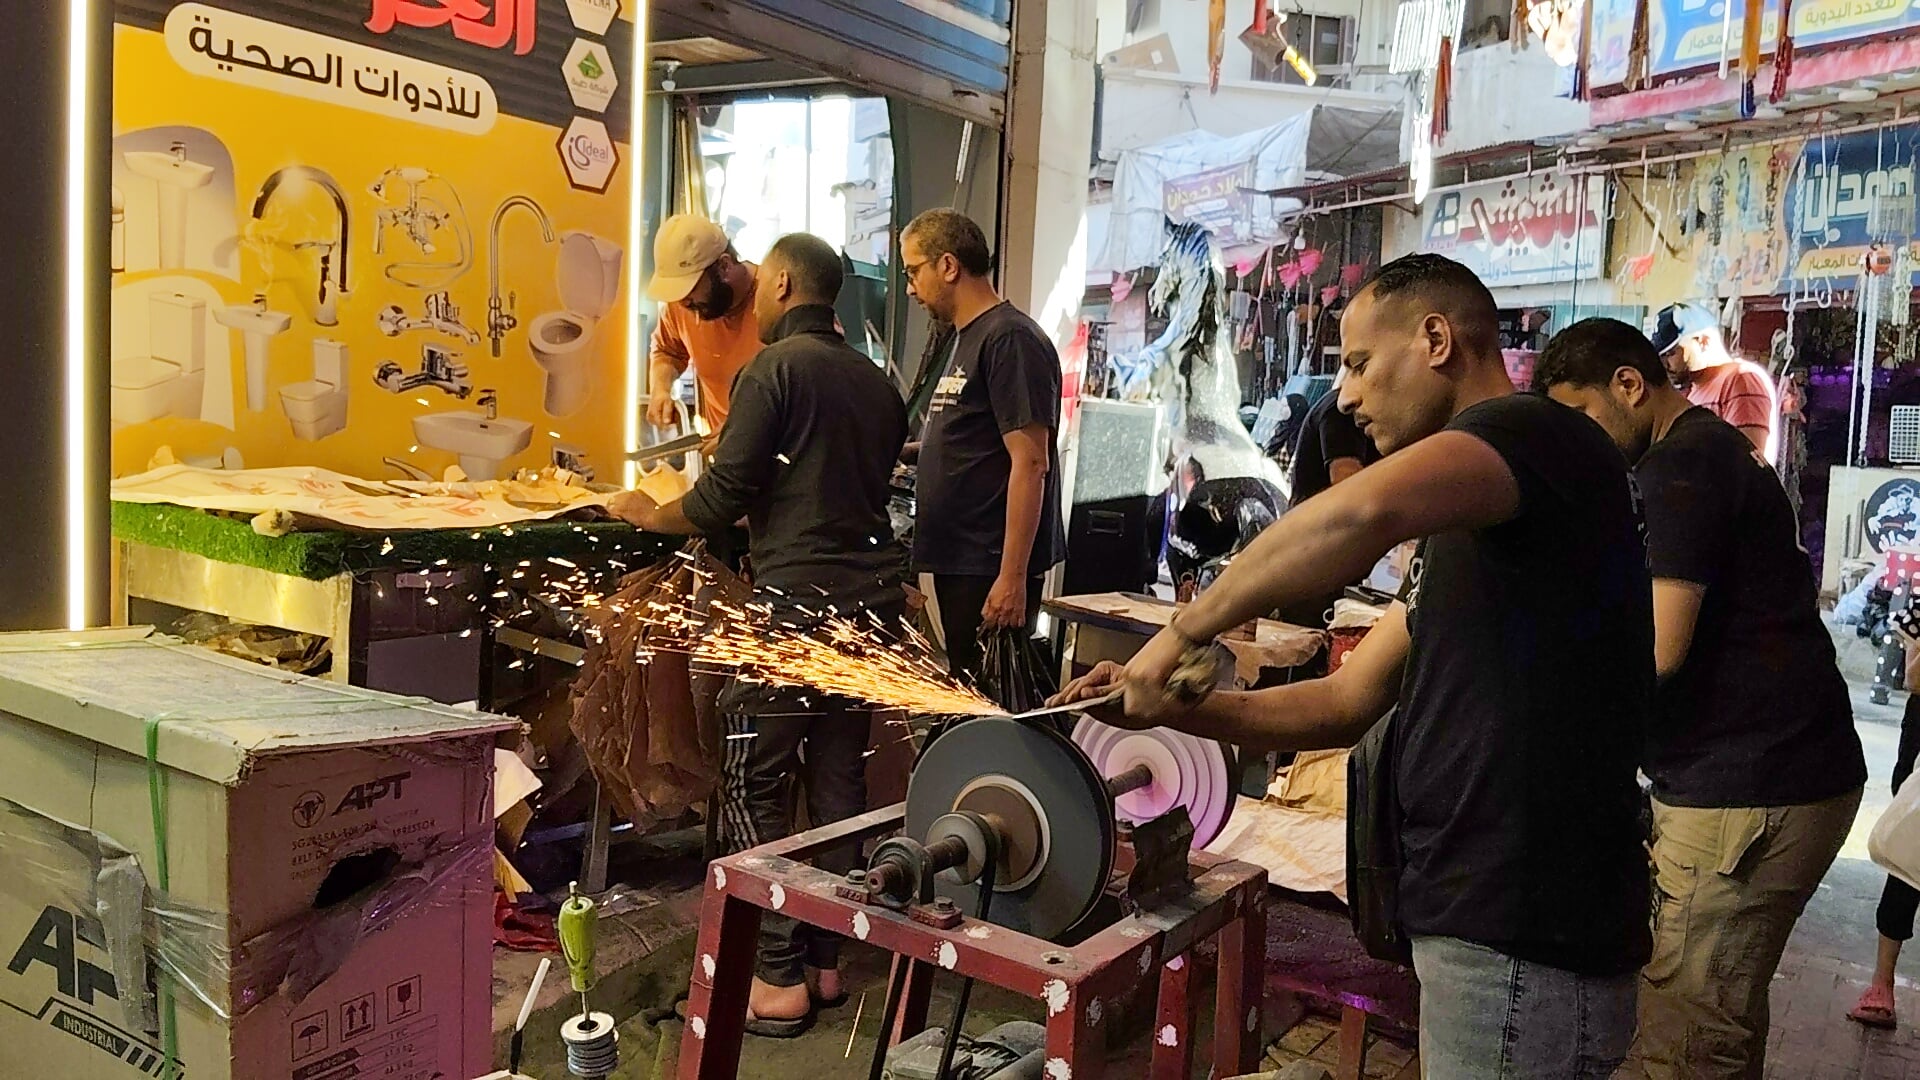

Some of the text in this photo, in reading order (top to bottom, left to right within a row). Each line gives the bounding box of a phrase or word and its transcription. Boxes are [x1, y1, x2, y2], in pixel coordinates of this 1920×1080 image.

[189, 15, 342, 88] الصحية
[353, 66, 480, 119] للأدوات
[331, 771, 411, 817] APT
[62, 1014, 120, 1055] INDUSTRIAL
